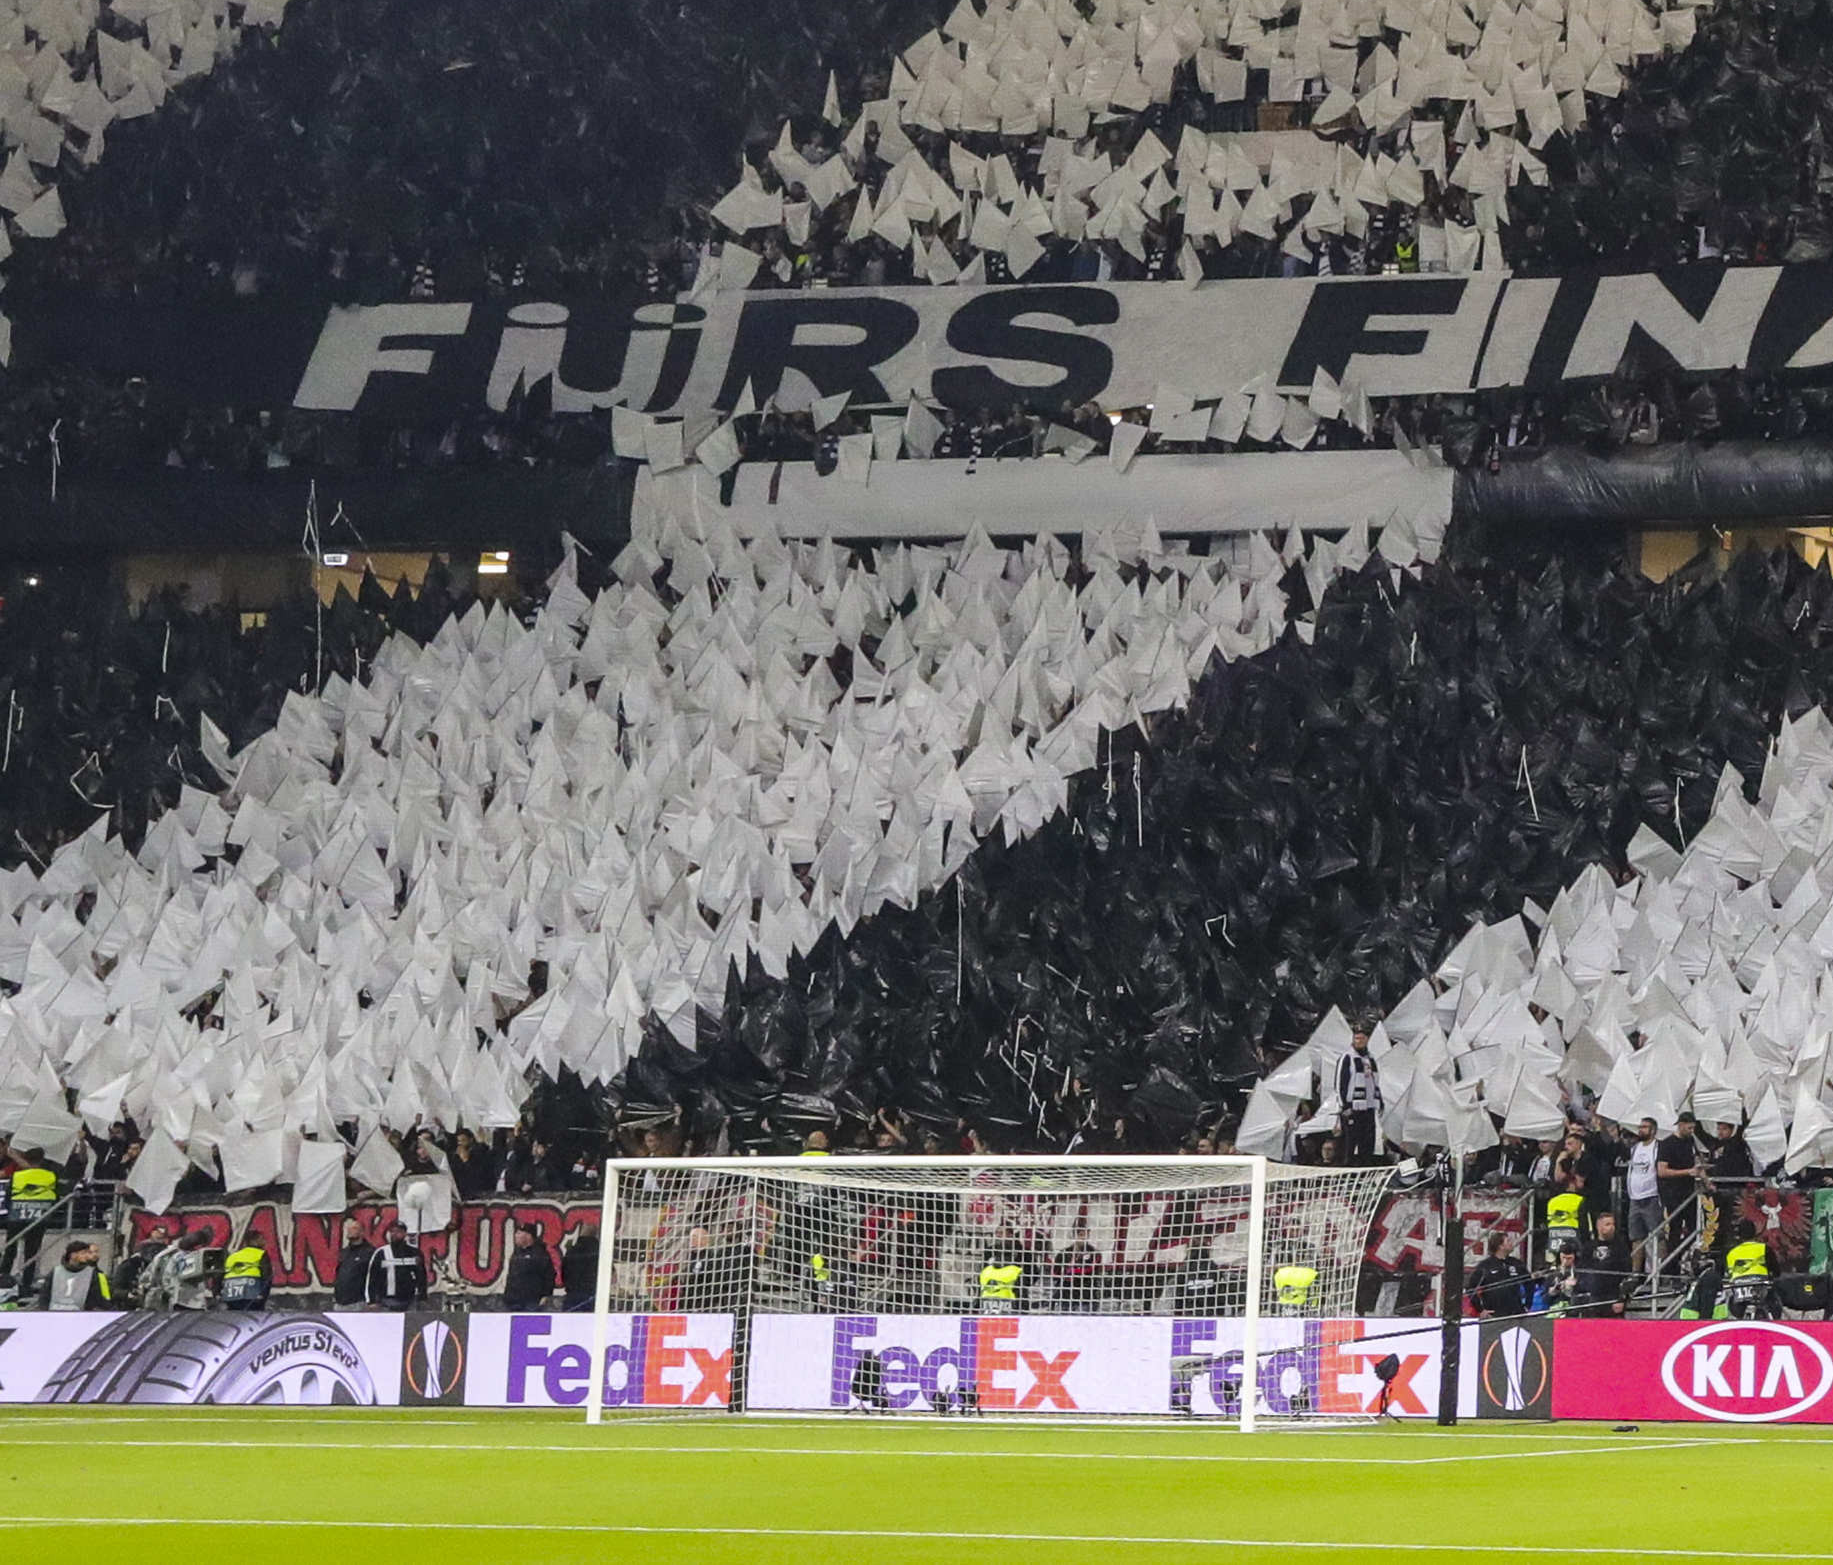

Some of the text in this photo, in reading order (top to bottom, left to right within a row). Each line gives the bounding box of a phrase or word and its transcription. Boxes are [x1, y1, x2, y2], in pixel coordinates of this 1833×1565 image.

[507, 1315, 733, 1405] FedEx
[831, 1317, 1080, 1409] FedEx
[1171, 1318, 1430, 1414] FedEx
[1692, 1345, 1805, 1399] KIA
